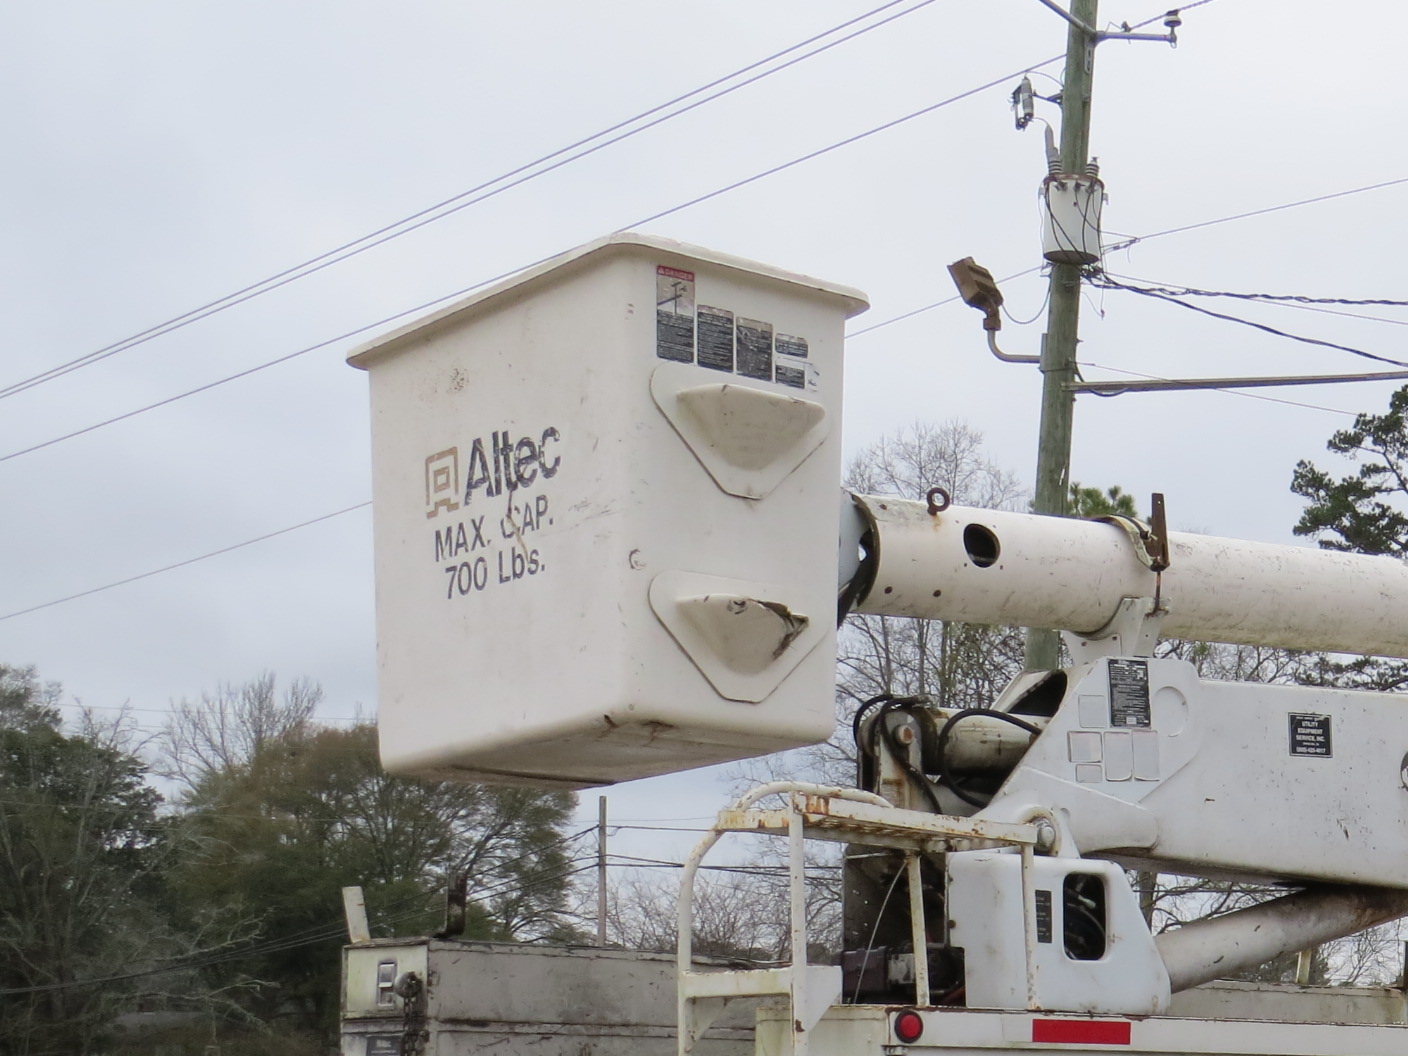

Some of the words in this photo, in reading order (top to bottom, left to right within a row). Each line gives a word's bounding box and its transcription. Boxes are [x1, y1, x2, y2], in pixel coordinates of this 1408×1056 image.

[464, 426, 561, 506] Altec
[435, 515, 491, 562] MAX.
[500, 494, 553, 539] CAP.
[445, 556, 488, 600] 700
[498, 546, 545, 584] Lbs.
